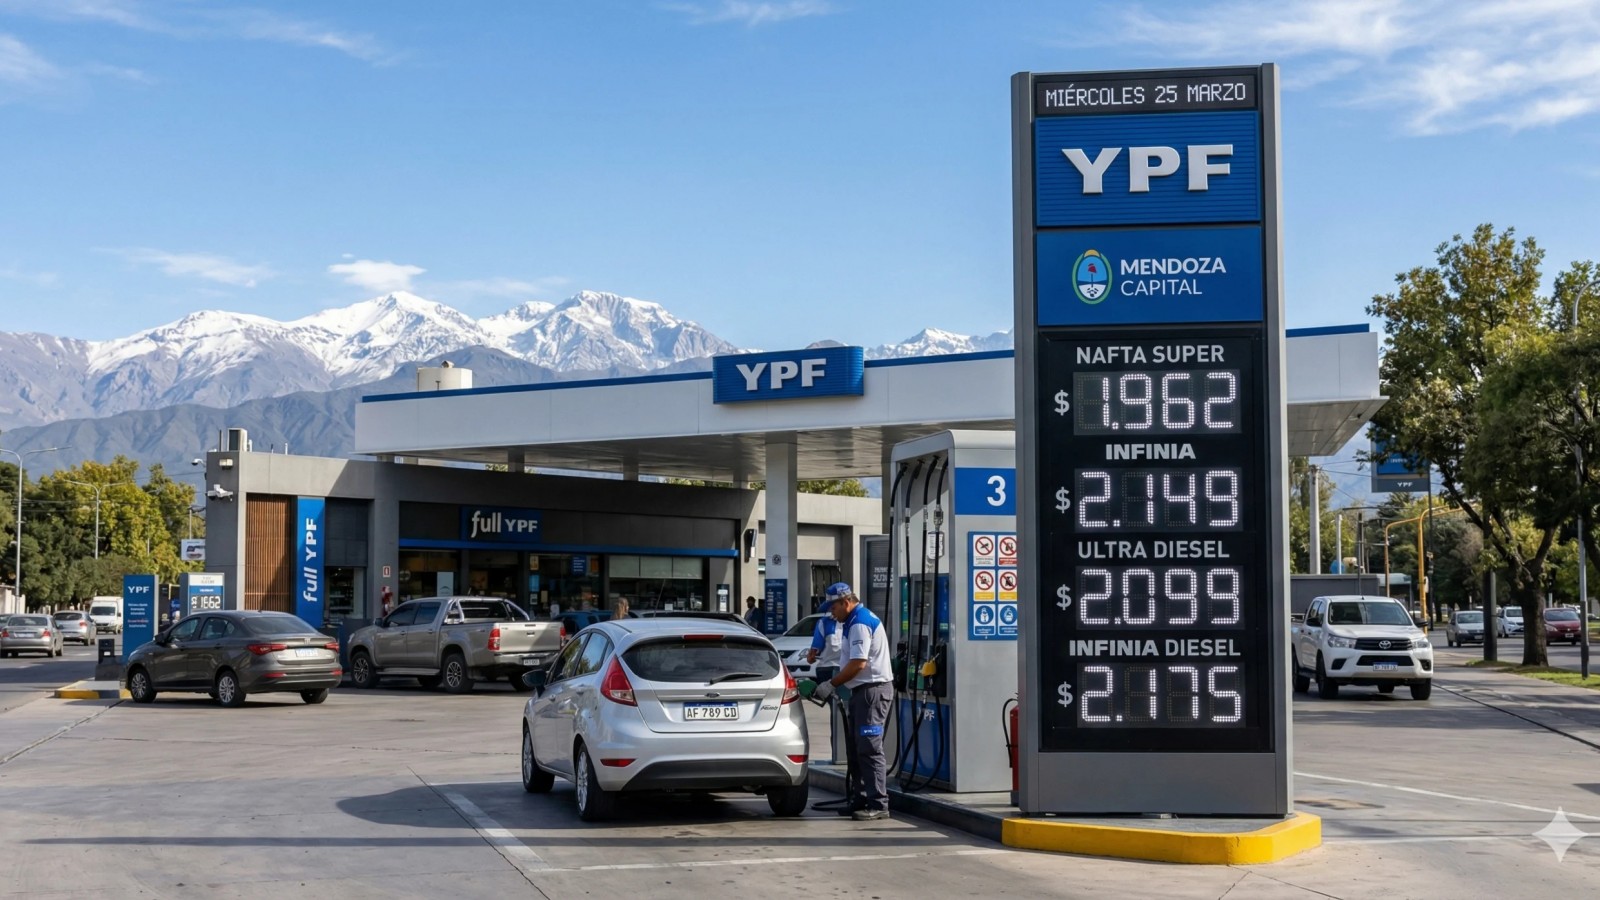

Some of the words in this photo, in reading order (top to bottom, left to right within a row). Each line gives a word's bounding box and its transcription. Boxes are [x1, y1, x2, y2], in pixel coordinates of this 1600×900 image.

[1045, 84, 1145, 107] MIÉRCOLES
[1155, 86, 1177, 103] 25
[1187, 83, 1246, 102] MARZO
[1061, 144, 1234, 193] YPF
[1120, 257, 1227, 276] MENDOZA
[1120, 279, 1203, 296] CAPITAL
[1076, 346, 1147, 364] NAFTA
[1152, 345, 1225, 363] SUPER
[736, 358, 826, 391] YPF
[1054, 389, 1070, 416] $
[1102, 372, 1236, 429] 1.962
[1105, 443, 1197, 460] INFINIA
[986, 475, 1006, 507] 3
[1055, 486, 1071, 513] $
[1079, 470, 1238, 527] 2.149
[470, 510, 502, 538] full
[504, 518, 539, 533] YPF
[305, 517, 317, 562] YPF
[1078, 541, 1148, 558] ULTRA
[1154, 540, 1230, 558] DIESEL
[128, 586, 150, 594] YPF
[303, 566, 318, 602] full
[1056, 584, 1072, 611] $
[1080, 568, 1239, 625] 2.099
[1069, 639, 1160, 656] INFINIA
[1165, 639, 1241, 656] DIESEL
[1057, 681, 1073, 708] $
[1081, 666, 1241, 722] 2.175
[686, 707, 699, 718] AF
[702, 707, 721, 718] 789
[724, 707, 738, 718] CD
